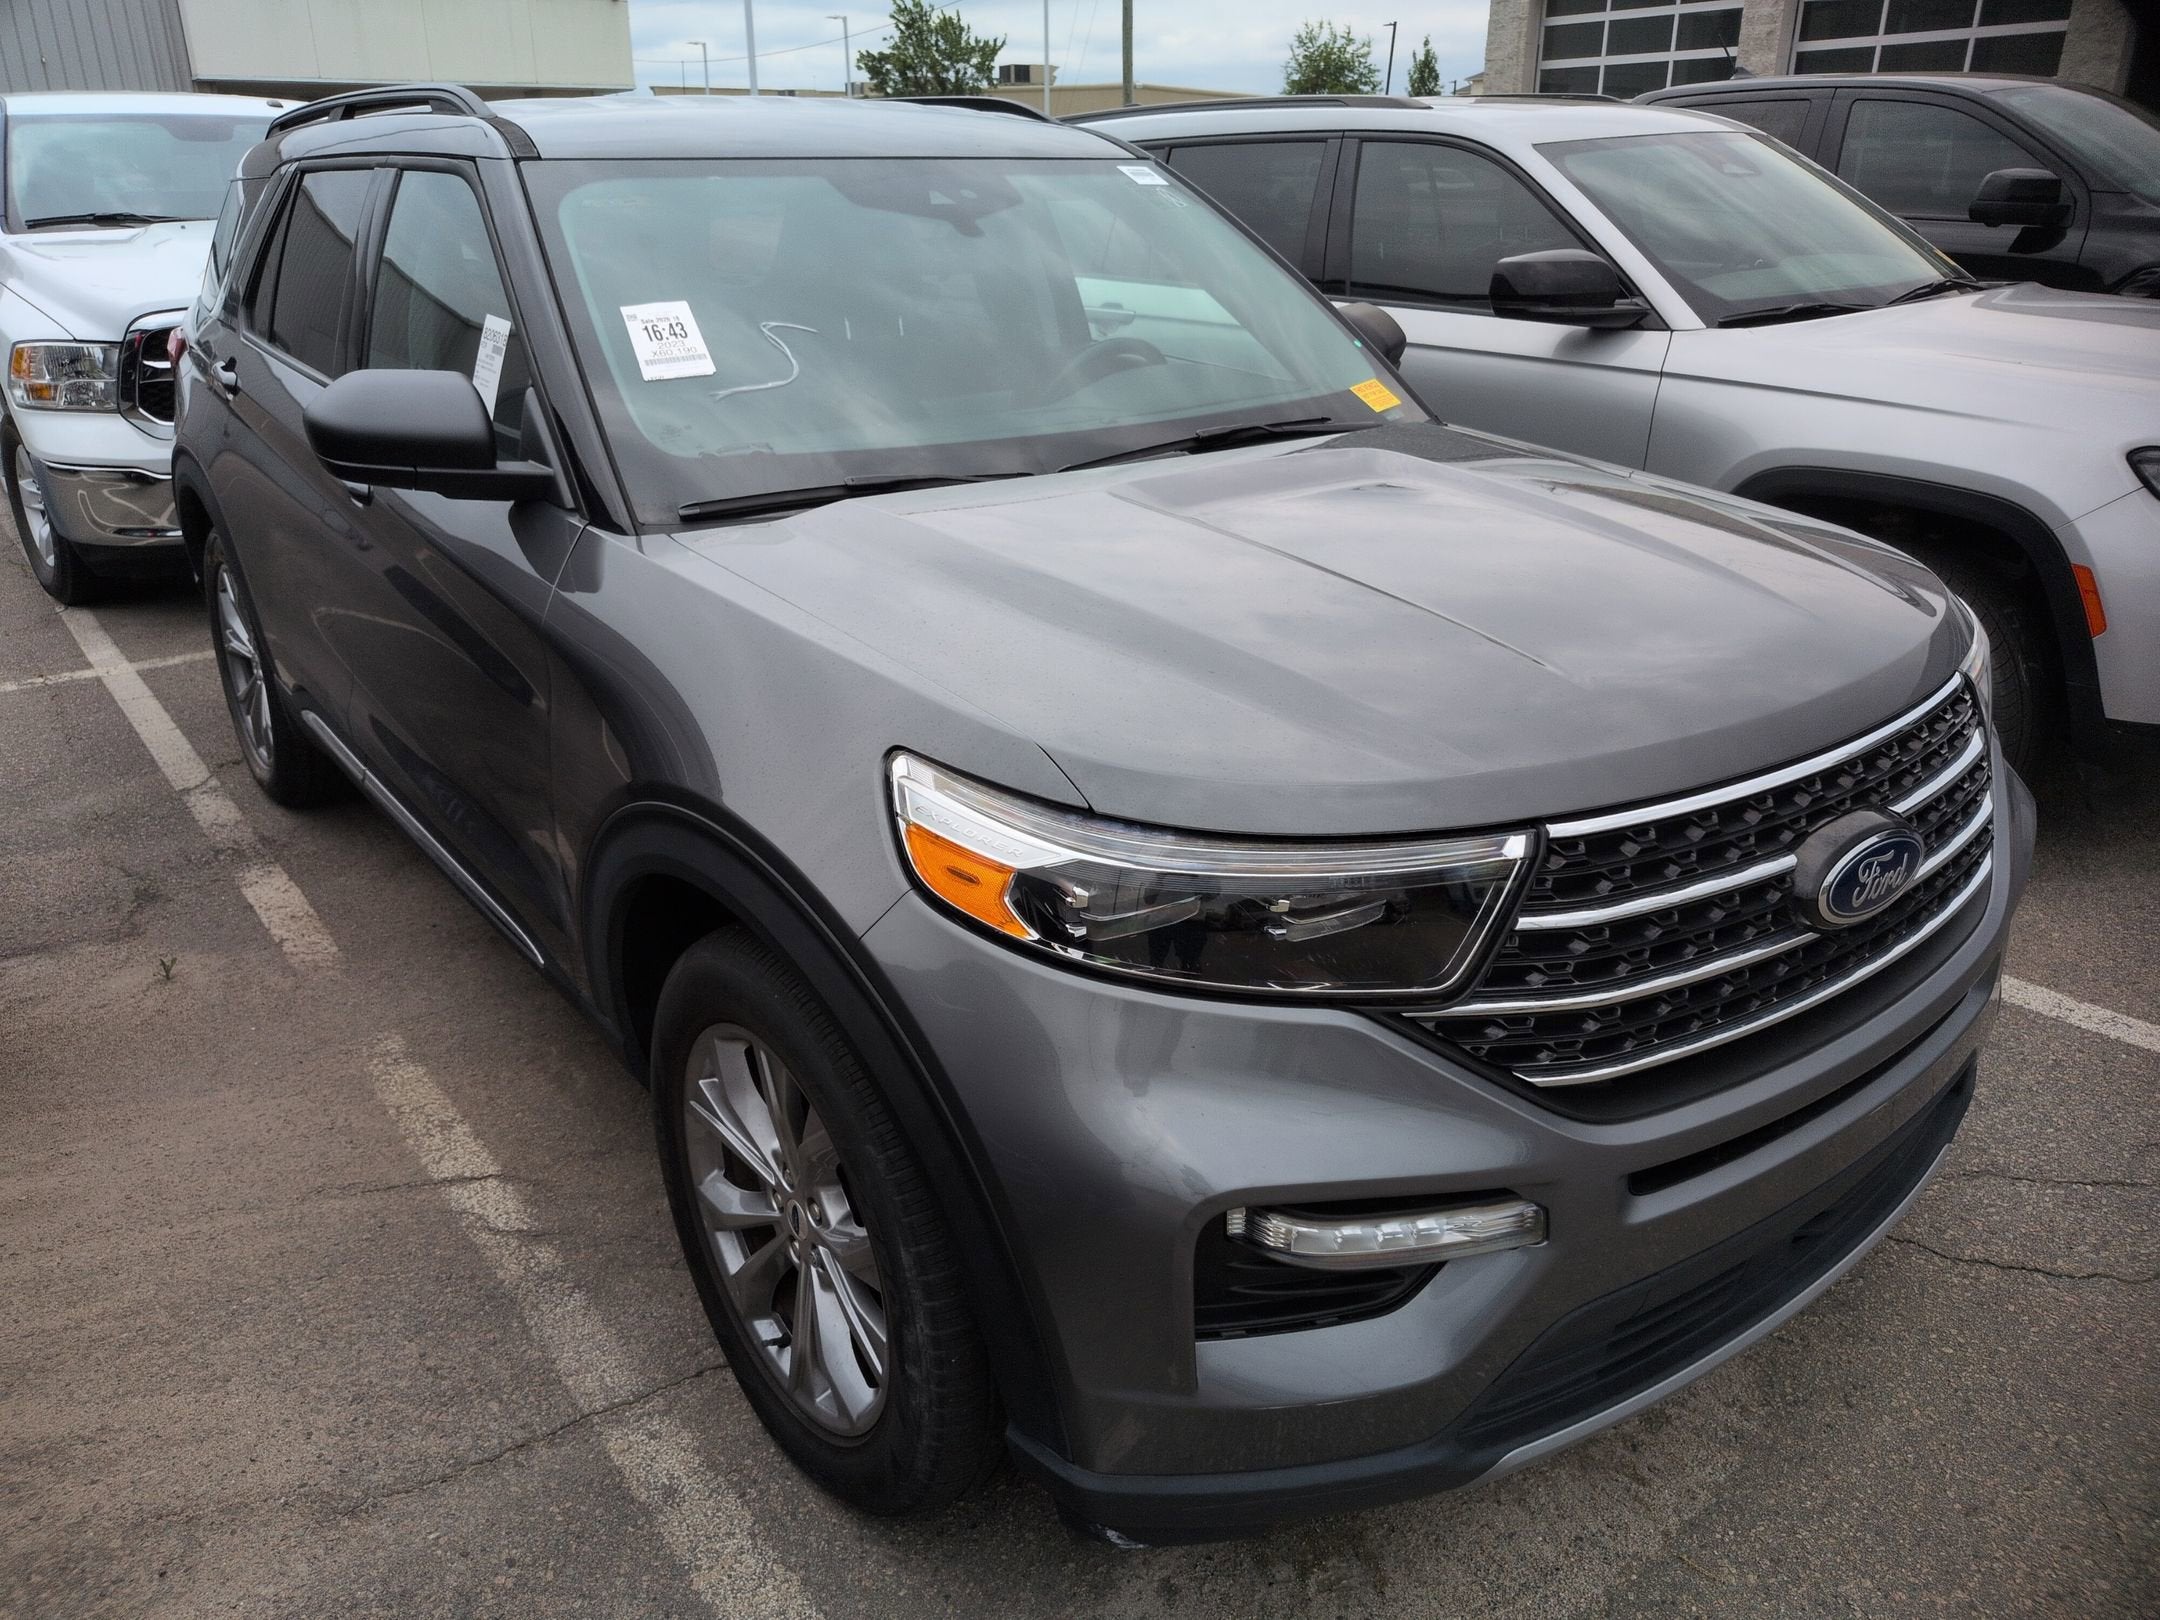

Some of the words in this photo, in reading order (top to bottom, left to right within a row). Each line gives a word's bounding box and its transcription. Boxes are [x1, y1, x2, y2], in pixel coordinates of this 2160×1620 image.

[641, 321, 689, 343] 16:43
[656, 340, 687, 350] 2023
[915, 804, 1024, 858] EXPLORER
[1852, 849, 1909, 908] Ford
